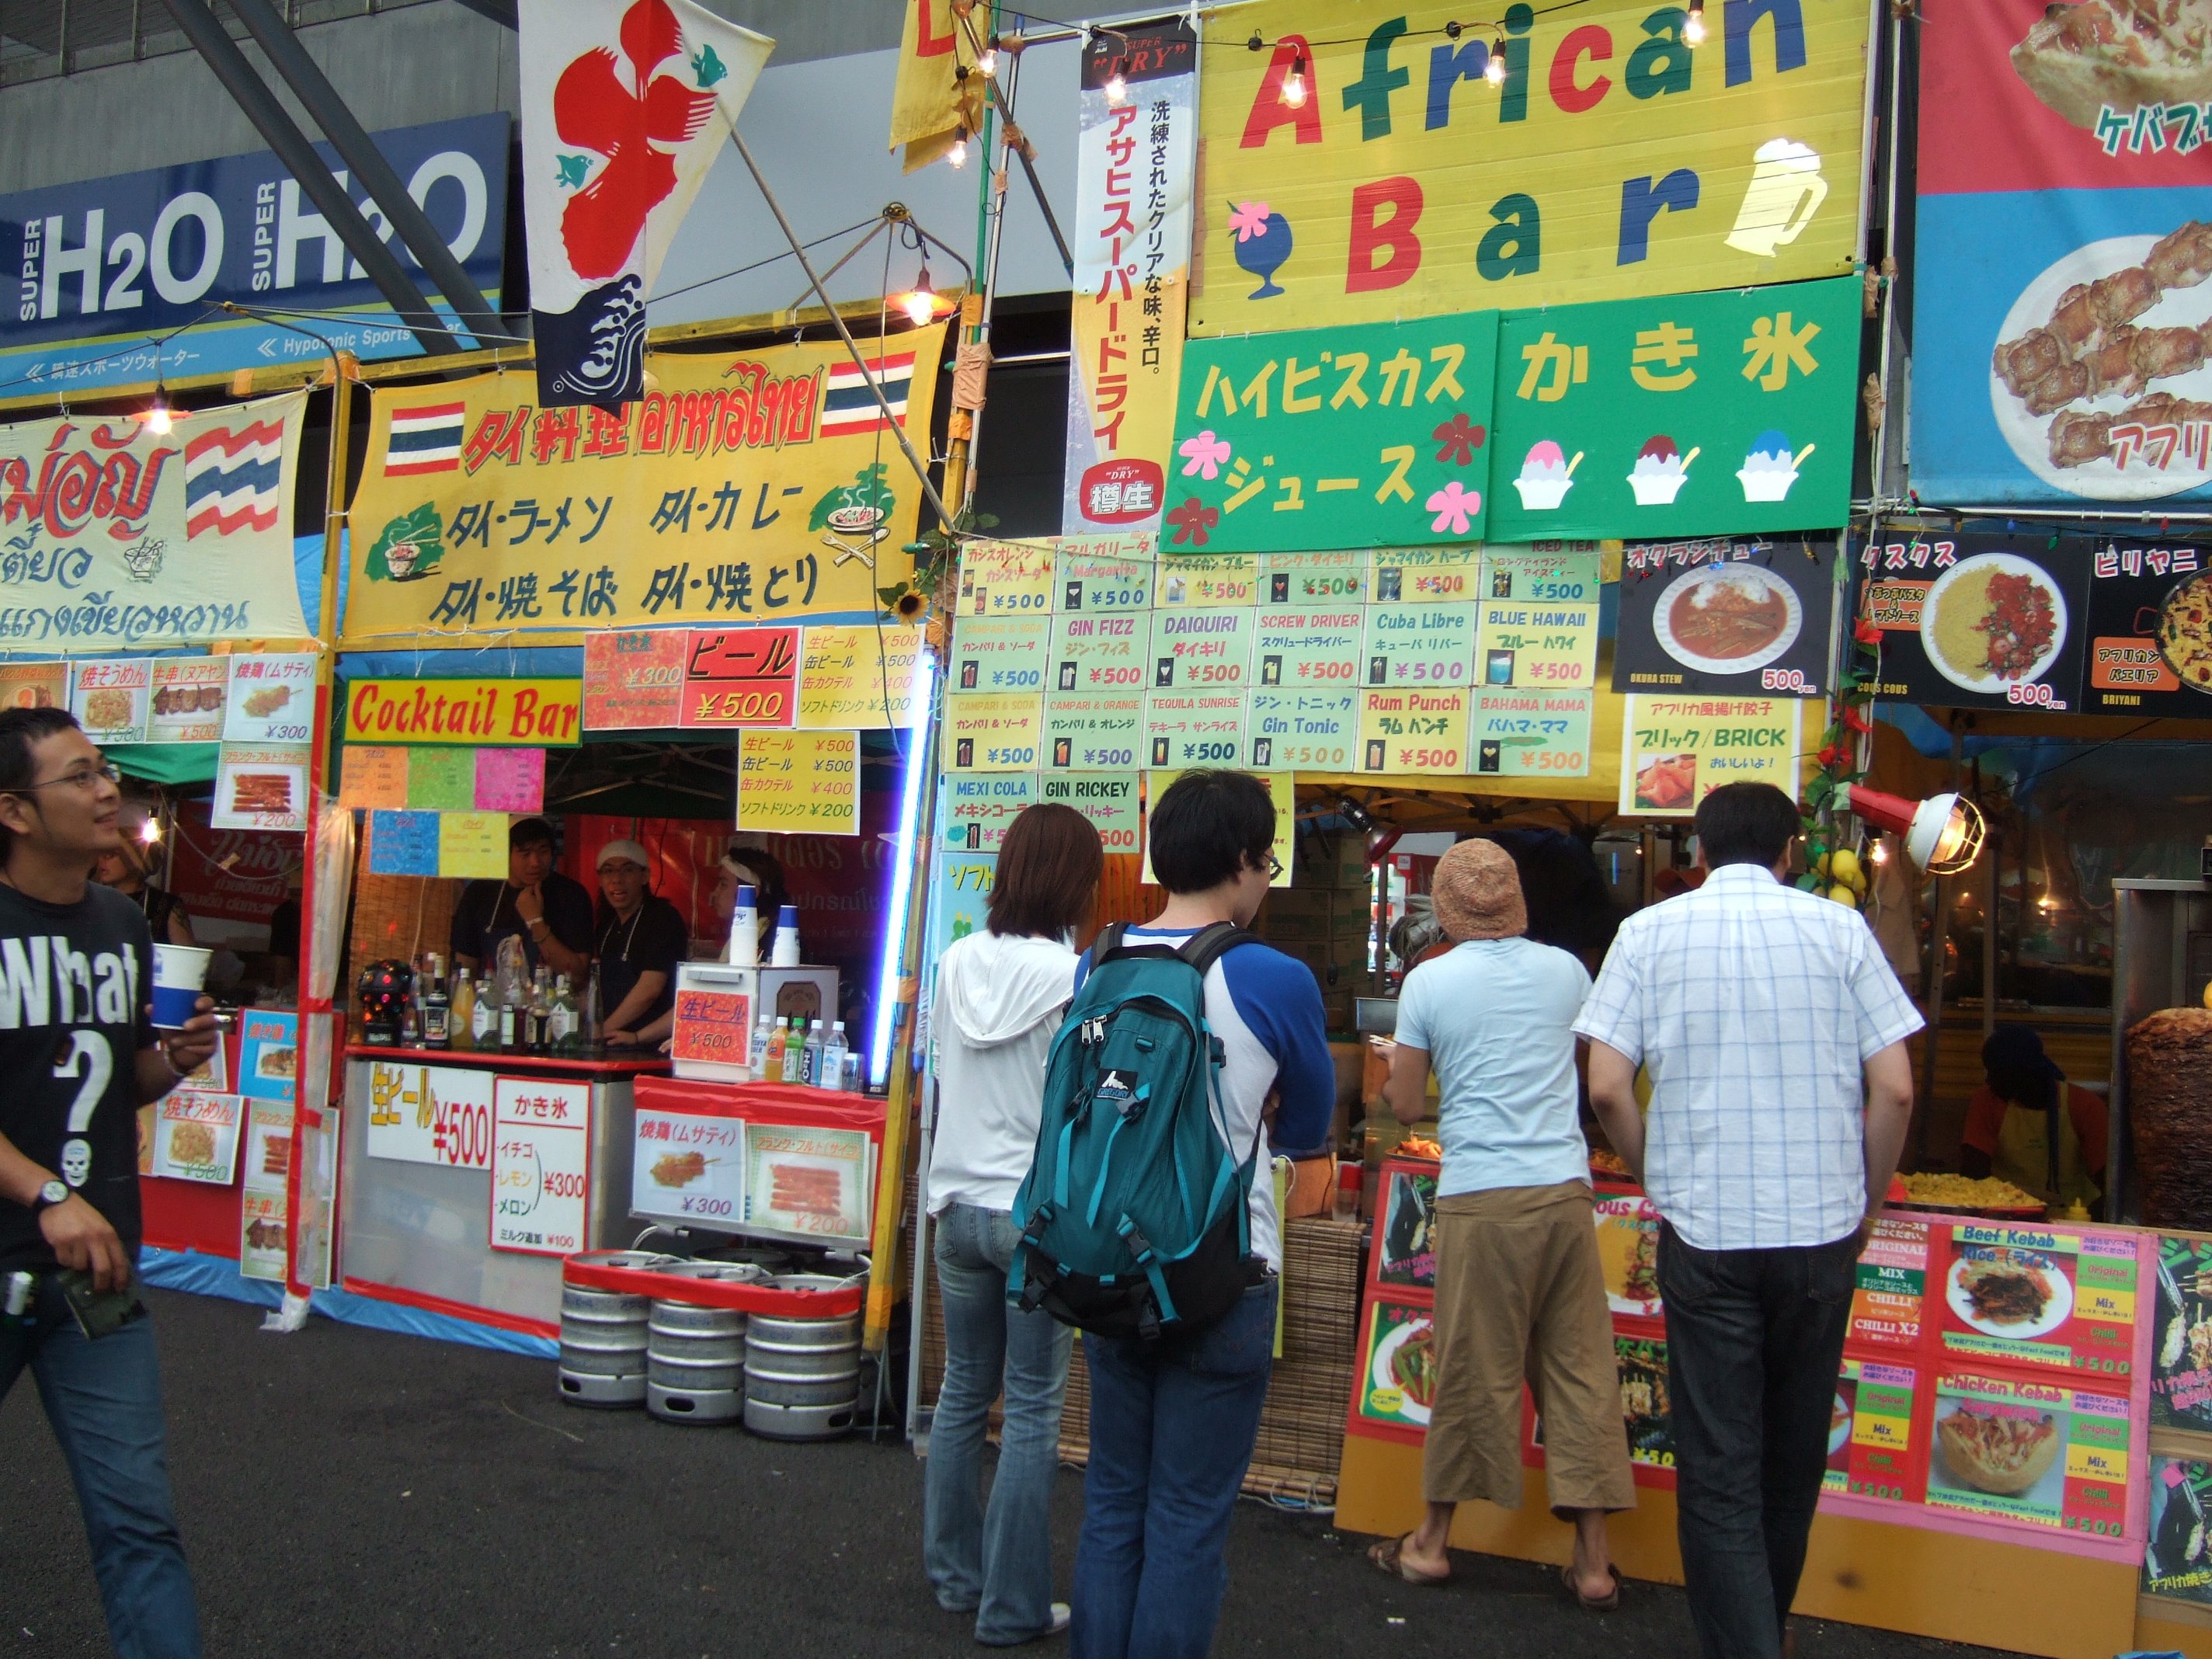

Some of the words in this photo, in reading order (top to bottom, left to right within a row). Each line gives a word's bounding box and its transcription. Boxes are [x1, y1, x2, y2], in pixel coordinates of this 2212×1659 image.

[1239, 0, 1807, 149] African
[252, 182, 276, 292] SUPER
[1140, 99, 1170, 376] 洗練されたクリアな味、辛口。
[1344, 167, 1700, 295] Bar
[40, 191, 224, 319] H2O
[20, 217, 41, 322] SUPER
[1094, 104, 1138, 450] アサヒスーパードライ
[283, 332, 356, 356] Hypotonic
[362, 325, 411, 348] Sports
[50, 350, 200, 381] 瞬速スポーツウォーター
[1515, 311, 1824, 404] かき氷
[1195, 343, 1467, 420] ハイビスカス
[635, 360, 824, 457] อาหารไทย
[461, 404, 630, 475] タイ料理
[1223, 443, 1417, 515] ジュース
[1088, 481, 1154, 515] 樽生
[649, 481, 804, 534] タイ・カレー
[447, 495, 614, 548] タイ・ラーメン
[1569, 540, 1595, 552] TEA
[641, 552, 819, 614] タイ・焼とり
[1416, 576, 1464, 593] ¥500
[1532, 583, 1584, 599] ¥500
[430, 564, 620, 623] タイ・焼そば
[994, 593, 1045, 609] ¥500
[1092, 590, 1144, 606] ¥500
[1164, 616, 1238, 634] DAIQUIRI
[1260, 615, 1306, 628] SCREW
[1309, 614, 1359, 628] DRIVER
[1376, 614, 1415, 629] Cuba
[1421, 613, 1464, 628] Libre
[1489, 611, 1525, 625] BLUE
[1532, 612, 1586, 626] HAWAII
[1068, 620, 1094, 636] GIN
[1099, 619, 1134, 635] FIZZ
[807, 635, 857, 649] 生ビール
[1172, 641, 1226, 657] ダイキリ
[688, 635, 795, 676] ビール
[805, 654, 854, 670] 缶ビール
[876, 654, 916, 667] ¥500
[2099, 649, 2160, 663] アフリカン
[626, 666, 682, 685] ¥300
[993, 670, 1039, 686] ¥500
[1090, 667, 1142, 684] ¥500
[1188, 664, 1241, 682] ¥500
[1298, 661, 1354, 680] ¥500
[1396, 662, 1462, 679] ¥500
[1530, 663, 1582, 679] ¥500
[1630, 673, 1657, 684] OKURA
[1659, 673, 1683, 684] STEW
[802, 676, 854, 690] 缶カクテル
[1883, 683, 1908, 695] COUS
[694, 692, 783, 719] ¥500
[800, 700, 864, 714] ソフトドリンク
[1050, 701, 1091, 711] CAMPARI
[1104, 700, 1139, 710] ORANGE
[1152, 699, 1194, 709] TEQUILA
[1198, 697, 1240, 708] SUNRISE
[1368, 694, 1402, 711] Rum
[1409, 694, 1461, 711] Punch
[1480, 698, 1539, 711] BAHAMA
[1545, 700, 1585, 711] MAMA
[2102, 694, 2141, 706] BRIYANI
[353, 684, 498, 736] Cocktail
[509, 688, 579, 739] Bar
[266, 725, 308, 739] ¥300
[1262, 718, 1288, 733] Gin
[1294, 718, 1339, 733] Tonic
[743, 737, 795, 752] 生ビール
[815, 739, 854, 753] ¥500
[1183, 743, 1236, 760] ¥500
[988, 748, 1034, 763] ¥500
[1084, 749, 1132, 765] ¥500
[1284, 746, 1344, 763] ¥500
[1400, 750, 1457, 767] ¥500
[1521, 751, 1582, 770] ¥500
[742, 757, 793, 772] 缶ビール
[813, 760, 854, 773] ¥500
[740, 777, 794, 793] 缶カクテル
[811, 782, 853, 795] ¥400
[957, 782, 989, 796] MEXI
[994, 781, 1027, 795] COLA
[1045, 782, 1069, 797] GIN
[1076, 782, 1129, 797] RICKEY
[741, 802, 806, 817] ソフトドリンク
[809, 803, 854, 818] ¥200
[253, 813, 297, 827] ¥200
[0, 936, 138, 1029] What
[690, 1032, 732, 1048] ¥500
[515, 1094, 569, 1118] かき氷
[433, 1100, 488, 1166] ¥500
[544, 1171, 585, 1198] ¥300
[683, 1197, 732, 1215] ¥300
[795, 1212, 849, 1234] ¥200
[547, 1233, 574, 1247] ¥100
[1963, 1226, 2002, 1243] Beef
[2007, 1229, 2055, 1248] Kebab
[1962, 1246, 1996, 1262] Rice
[1878, 1267, 1905, 1278] MIX
[1867, 1292, 1914, 1306] CHILLI
[2095, 1297, 2116, 1309] Mix
[1855, 1318, 1895, 1335] CHILLI
[1898, 1321, 1919, 1336] X2
[2075, 1356, 2131, 1376] ¥500
[2013, 1384, 2063, 1403] Kebab
[1873, 1424, 1891, 1435] Mix
[2088, 1456, 2107, 1469] Mix
[2065, 1517, 2122, 1537] ¥500
